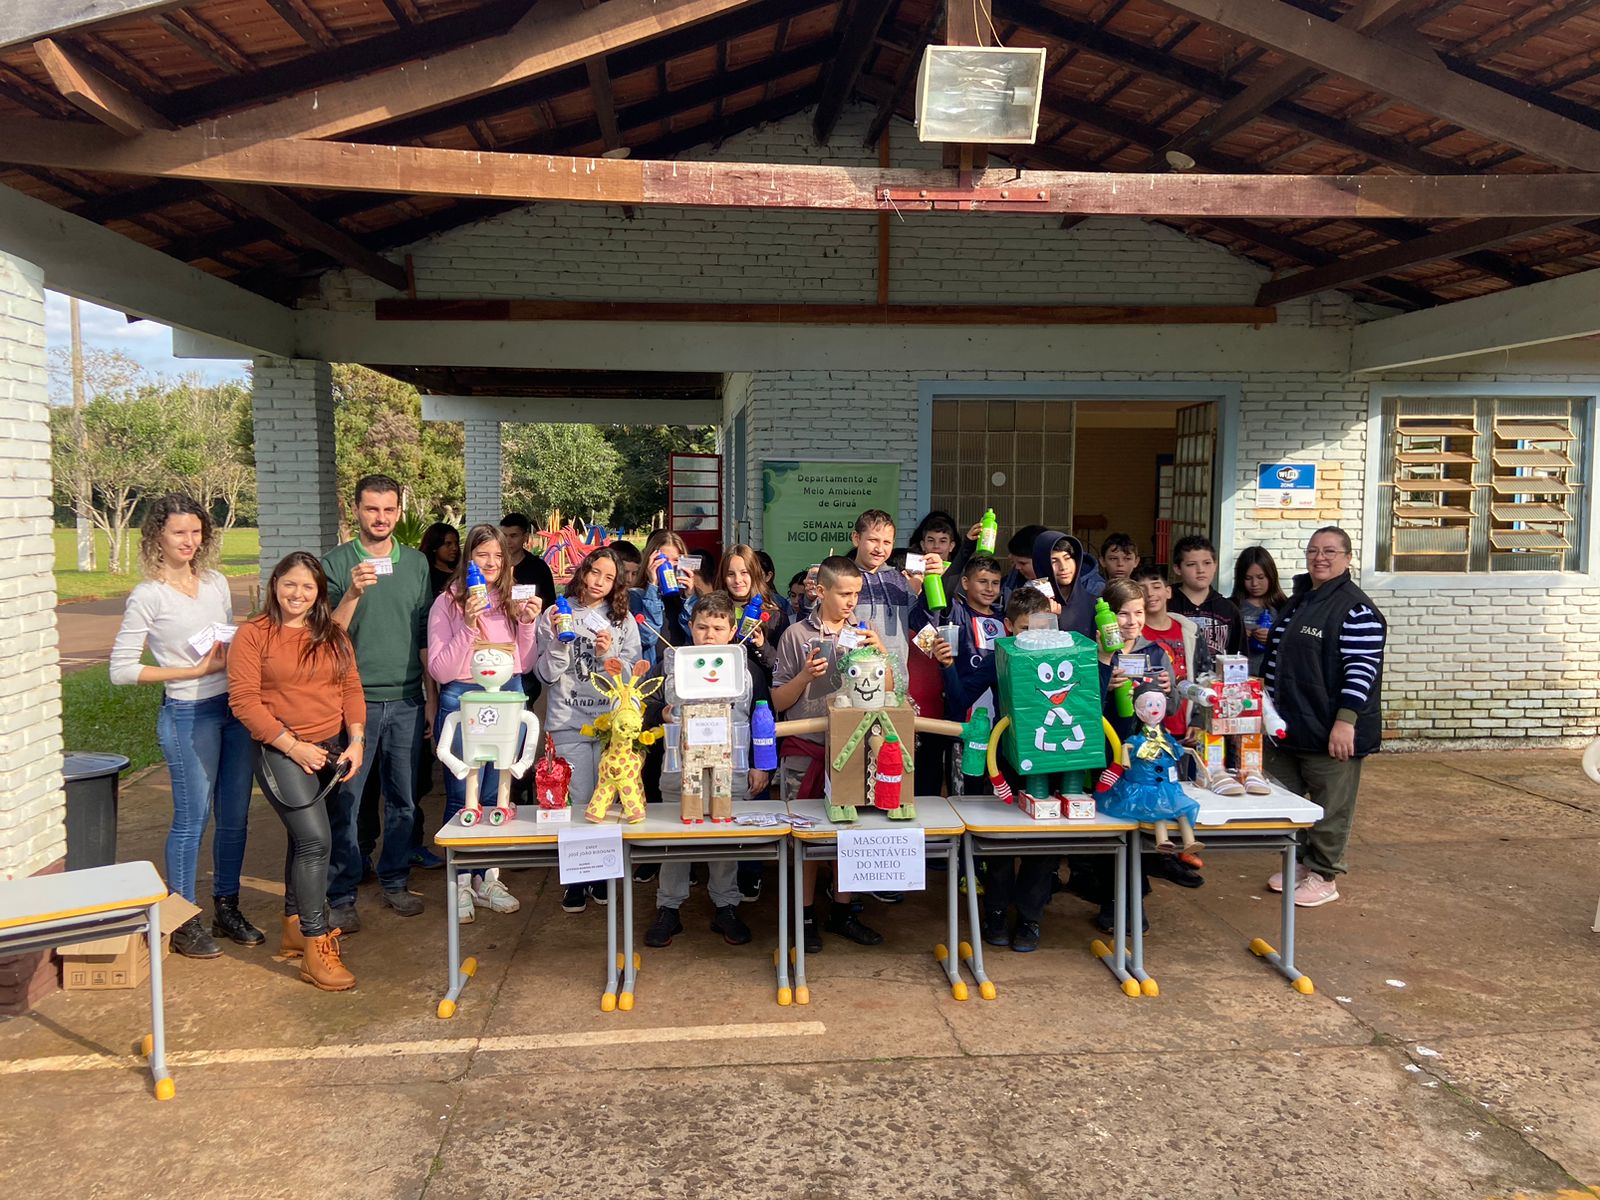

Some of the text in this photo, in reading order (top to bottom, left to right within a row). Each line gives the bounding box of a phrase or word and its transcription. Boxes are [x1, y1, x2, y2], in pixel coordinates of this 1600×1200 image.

[797, 474, 878, 484] Departamento de
[803, 487, 872, 496] Meio Ambiente
[818, 499, 857, 508] de Giruá
[803, 521, 856, 530] SEMANA D
[787, 532, 853, 543] MEIO AMBI
[1300, 625, 1323, 638] FASA
[565, 698, 594, 707] HAND
[853, 836, 908, 845] MASCOTES
[841, 847, 917, 858] SUSTENTÁVEIS
[857, 860, 901, 869] DO MEIO
[852, 872, 905, 881] AMBIENTE
